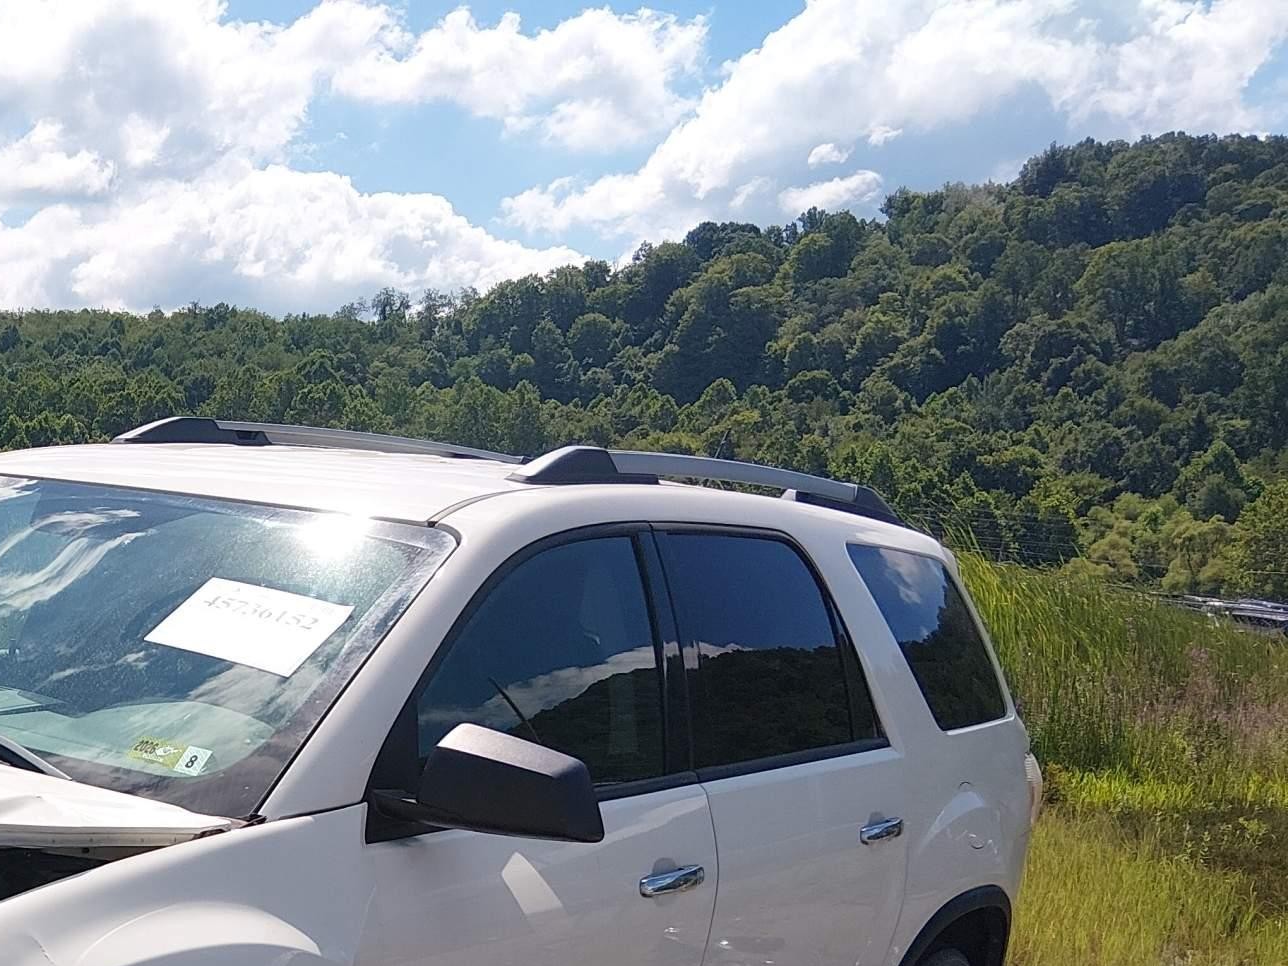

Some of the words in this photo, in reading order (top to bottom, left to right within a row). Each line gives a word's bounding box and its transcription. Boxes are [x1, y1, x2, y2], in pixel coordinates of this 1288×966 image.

[203, 595, 319, 630] 45736152
[133, 739, 160, 755] 2026
[184, 754, 199, 769] 8
